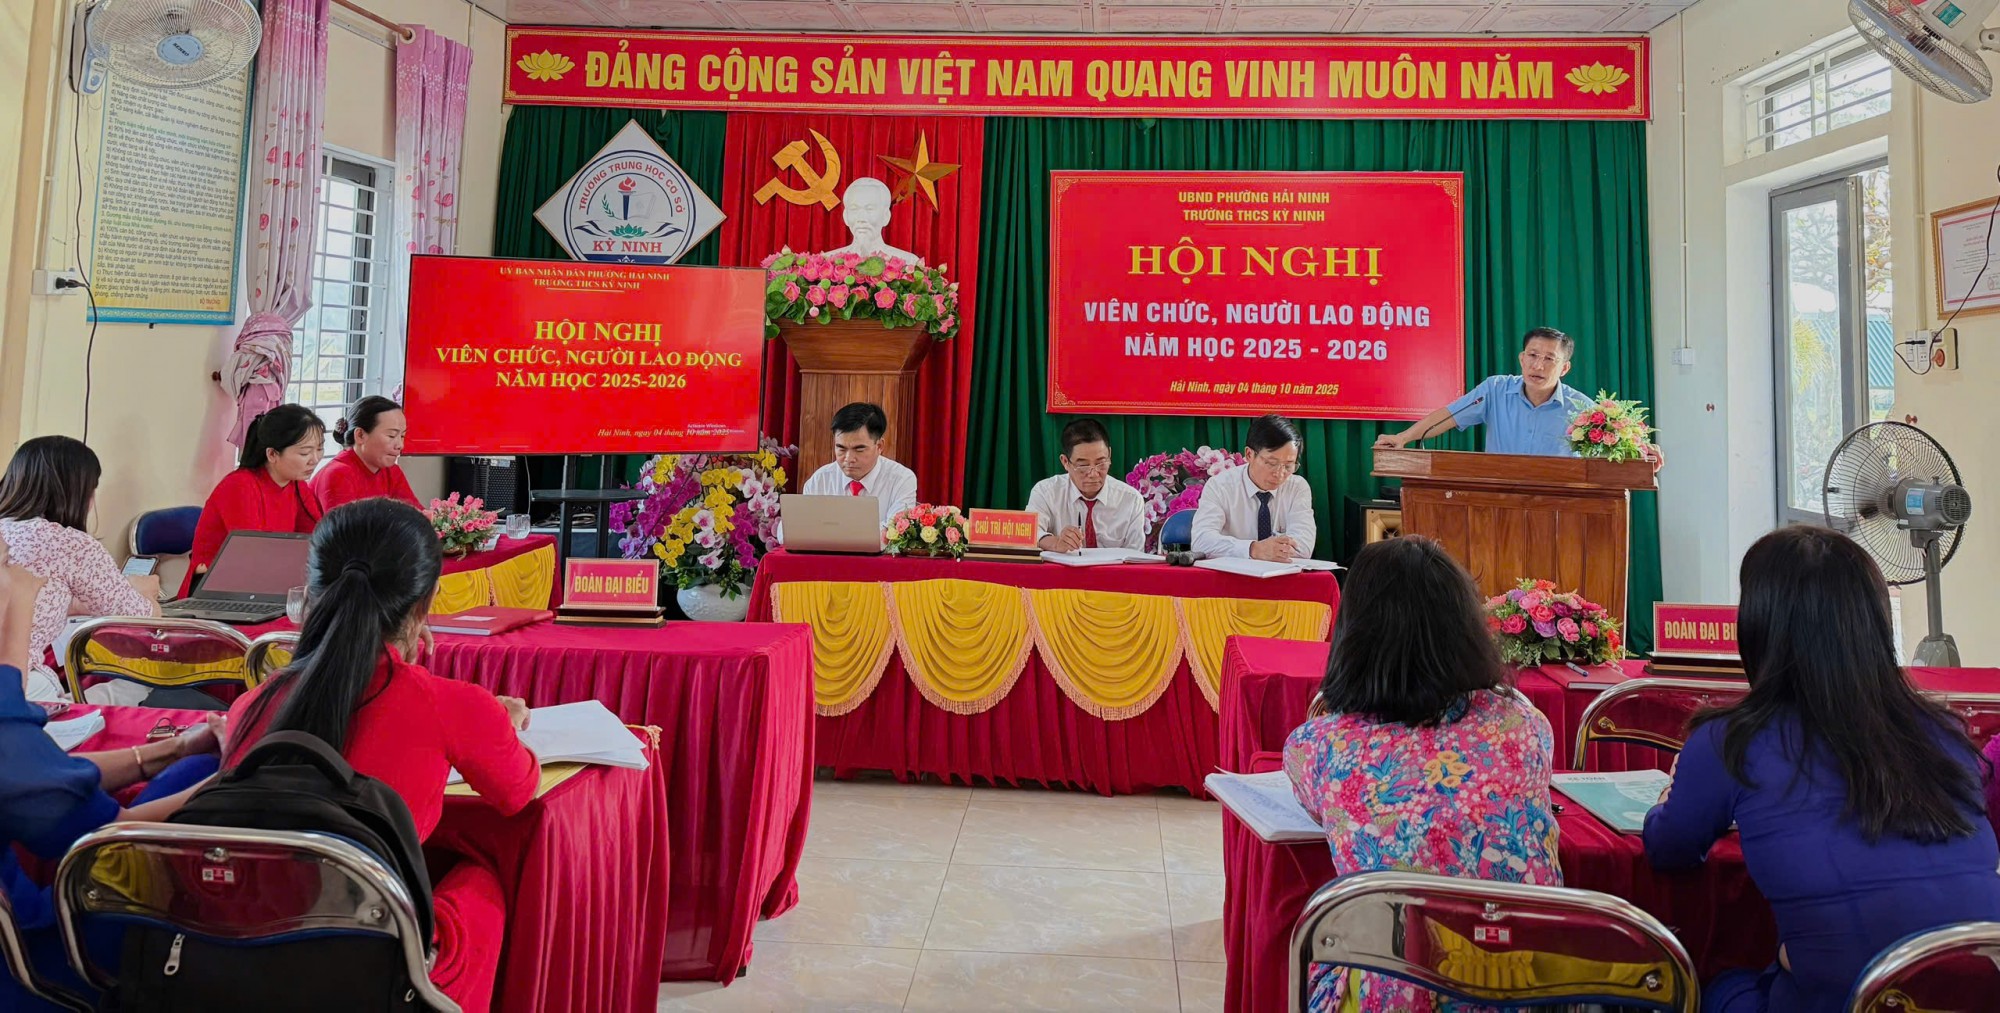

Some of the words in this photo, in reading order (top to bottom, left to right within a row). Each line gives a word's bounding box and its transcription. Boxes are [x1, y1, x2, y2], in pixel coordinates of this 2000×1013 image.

[585, 37, 686, 90] ĐẢNG
[699, 48, 798, 100] CỘNG
[811, 42, 888, 94] SẢN
[899, 51, 975, 105] VIỆT
[987, 60, 1073, 96] NAM
[1087, 60, 1212, 101] QUANG
[1225, 61, 1316, 100] VINH
[1328, 53, 1446, 99] MUÔN
[1461, 54, 1553, 99] NĂM
[579, 171, 607, 210] TRƯỜNG
[608, 161, 643, 173] TRUNG
[645, 163, 666, 180] HỌC
[665, 178, 678, 195] CƠ
[673, 196, 686, 213] SỞ
[1179, 192, 1213, 202] UBND
[1217, 190, 1268, 203] PHƯỜNG
[1273, 189, 1293, 203] HẢI
[1298, 192, 1329, 203] NINH
[1184, 208, 1233, 221] TRƯỜNG
[1237, 210, 1269, 221] THCS
[1273, 208, 1289, 221] KỲ
[1293, 211, 1324, 221] NINH
[592, 237, 616, 252] KỲ
[621, 241, 663, 253] NINH
[1128, 237, 1225, 284] HỘI
[1242, 247, 1382, 285] NGHỊ
[576, 279, 600, 288] THCS
[617, 281, 640, 290] NINH
[1084, 298, 1138, 322] VIÊN
[1147, 299, 1217, 325] CHỨC,
[1227, 300, 1300, 324] NGƯỜI
[1310, 305, 1353, 325] LAO
[1362, 302, 1429, 330] ĐỘNG
[535, 319, 586, 346] HỘI
[594, 323, 662, 347] NGHỊ
[436, 344, 488, 362] VIÊN
[494, 346, 561, 366] CHỨC,
[567, 347, 634, 365] NGƯỜI
[640, 352, 681, 365] LAO
[686, 350, 742, 369] ĐỘNG
[1125, 333, 1178, 356] NĂM
[1188, 338, 1234, 361] HỌC
[1243, 338, 1301, 358] 2025
[1328, 340, 1387, 360] 2026
[496, 369, 545, 387] NĂM
[551, 373, 596, 391] HỌC
[601, 373, 686, 388] 2025-2026
[1169, 379, 1186, 393] Hải
[1186, 381, 1211, 394] Ninh,
[1212, 381, 1237, 396] ngày
[1237, 381, 1250, 394] 04
[1250, 382, 1278, 396] tháng
[1280, 382, 1292, 395] 10
[1292, 383, 1314, 395] năm
[1314, 383, 1340, 396] 2025
[613, 428, 632, 437] Ninh,
[653, 428, 662, 437] 04
[664, 428, 684, 438] tháng
[975, 517, 988, 534] CHỦ
[991, 519, 1000, 535] TRÌ
[1002, 519, 1014, 539] HỘI
[1015, 522, 1032, 540] NGHỊ
[574, 572, 603, 593] ĐOÀN
[605, 576, 623, 598] ĐẠI
[625, 570, 649, 594] BIỂU
[1664, 617, 1697, 640] ĐOÀN
[1699, 622, 1720, 645] ĐẠI
[1722, 622, 1738, 641] BI
